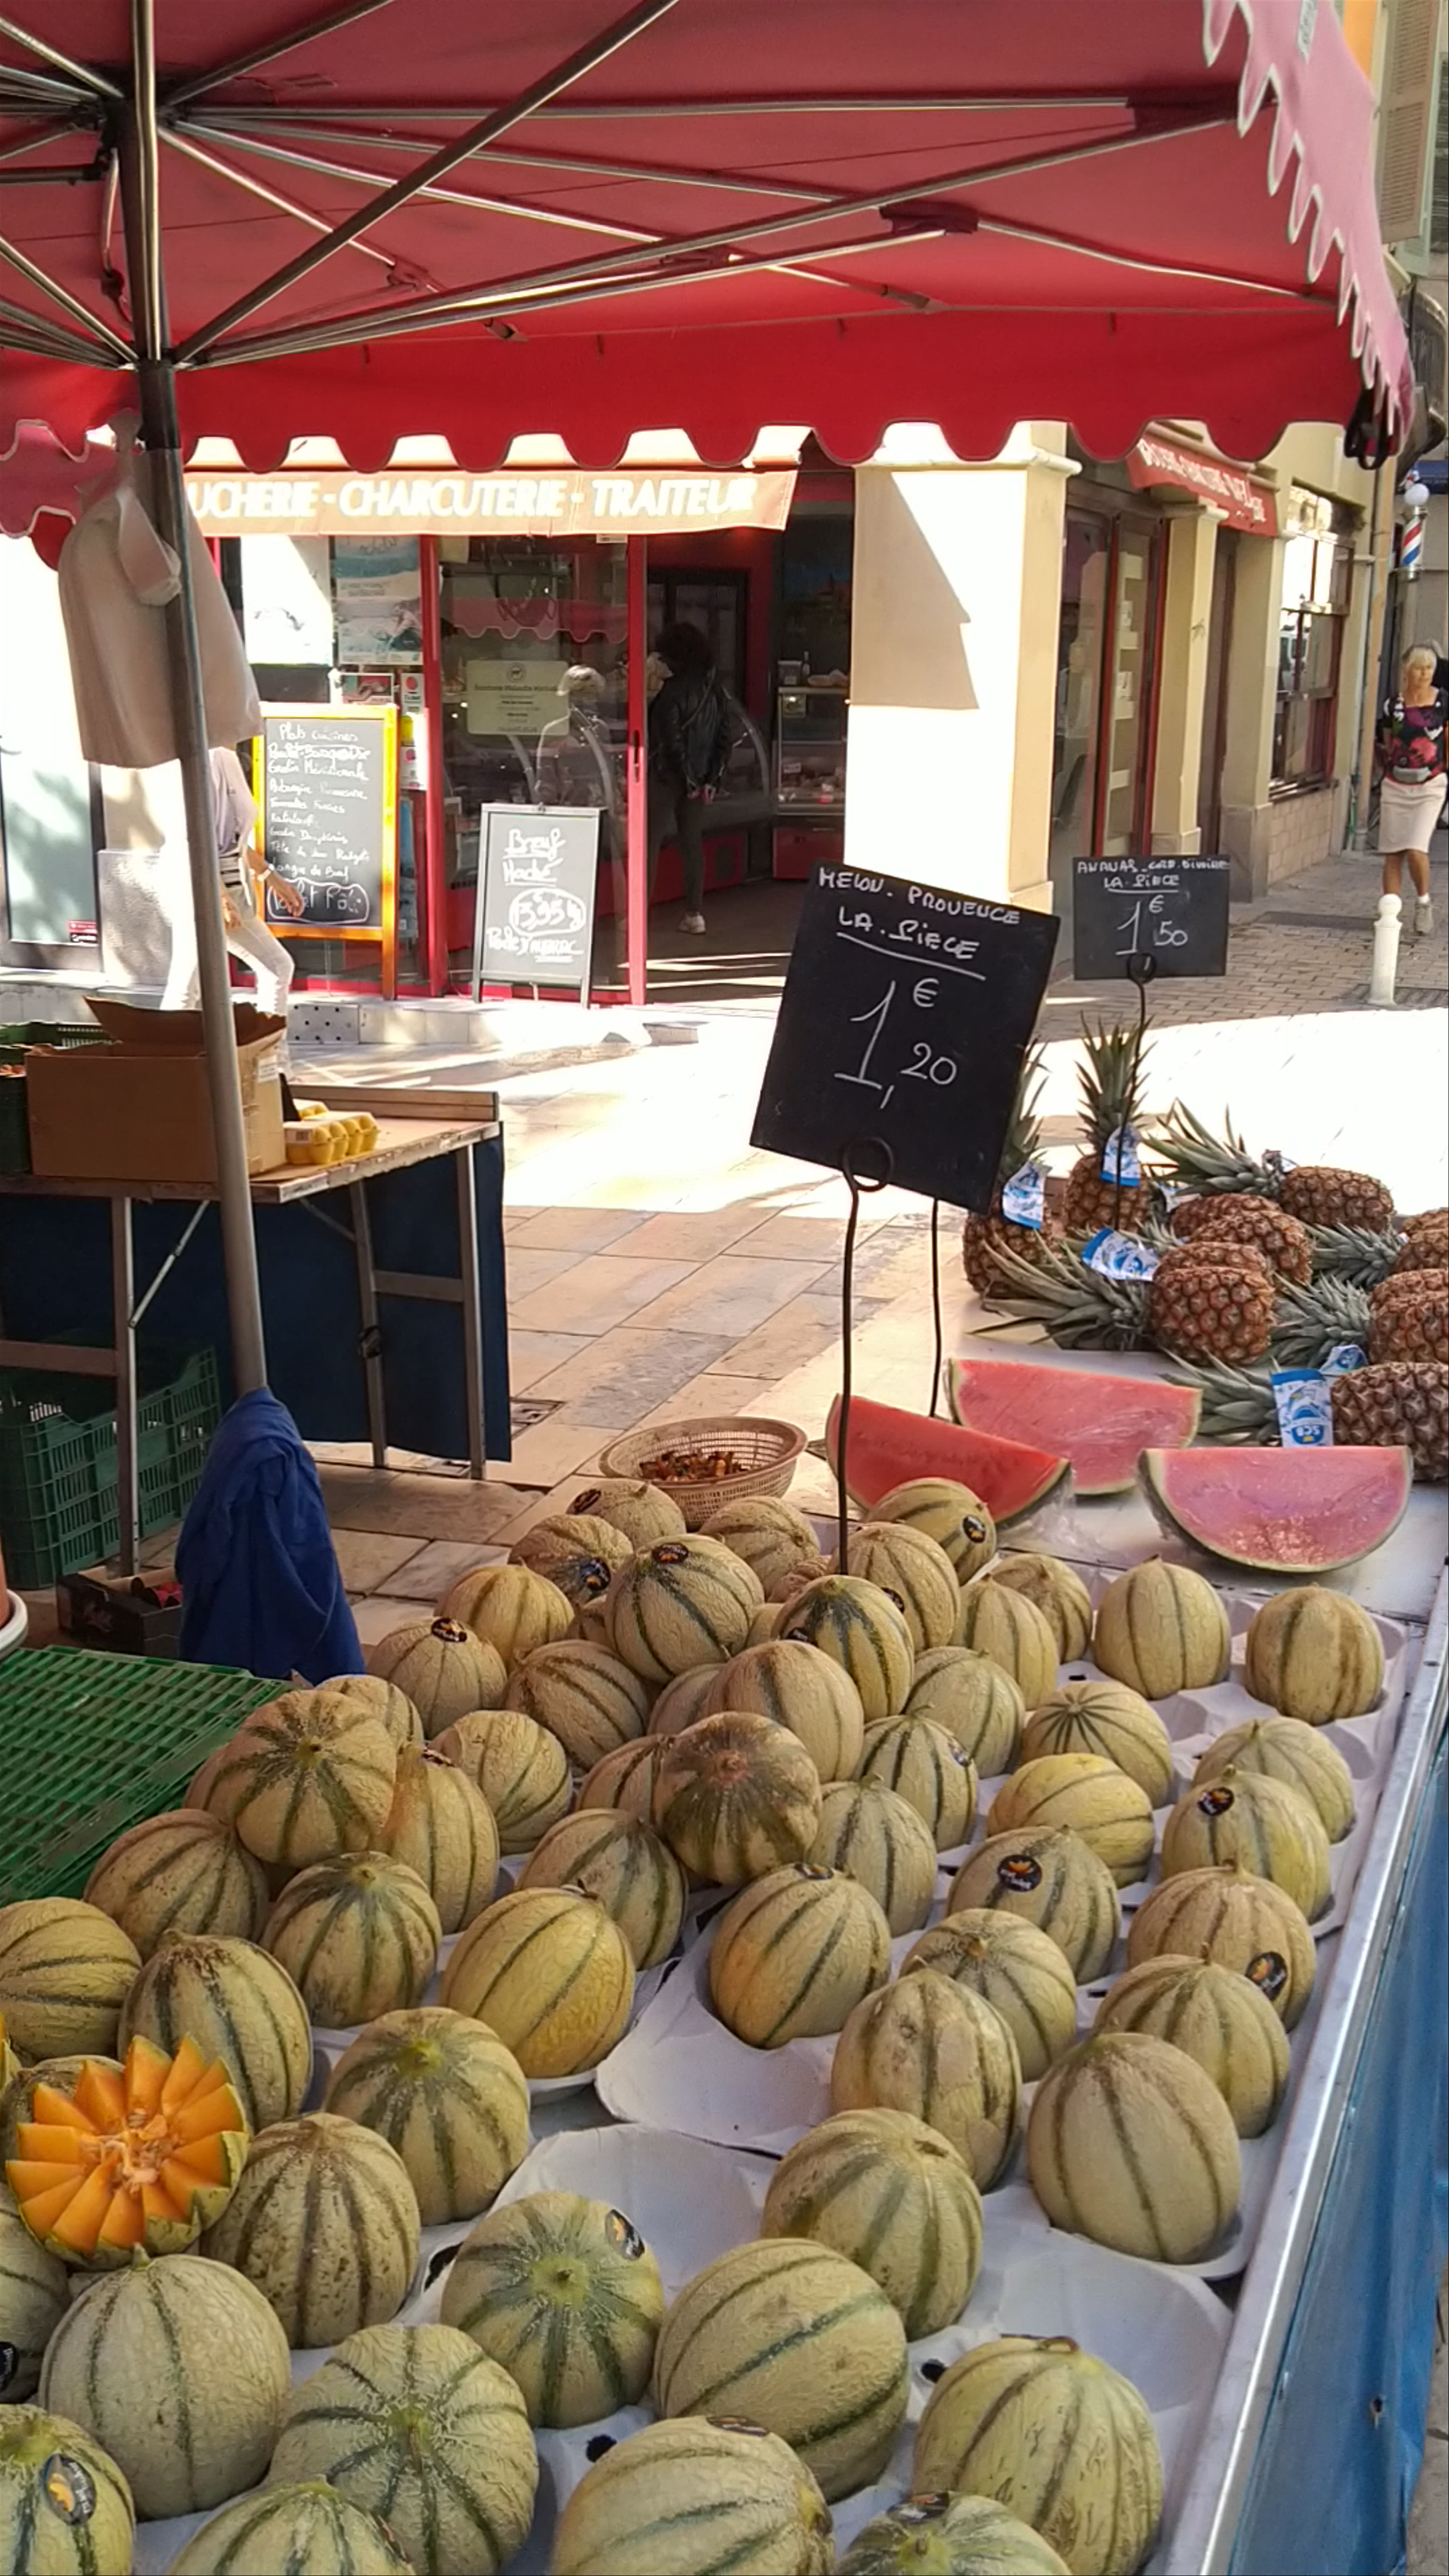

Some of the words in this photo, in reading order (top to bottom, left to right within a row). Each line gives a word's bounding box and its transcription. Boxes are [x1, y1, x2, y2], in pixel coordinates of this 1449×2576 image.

[339, 478, 567, 517] CHARCUTERIE
[592, 478, 757, 517] TRAITEUR
[1077, 860, 1137, 874] ANANAS
[908, 886, 1020, 924] PROVENCE
